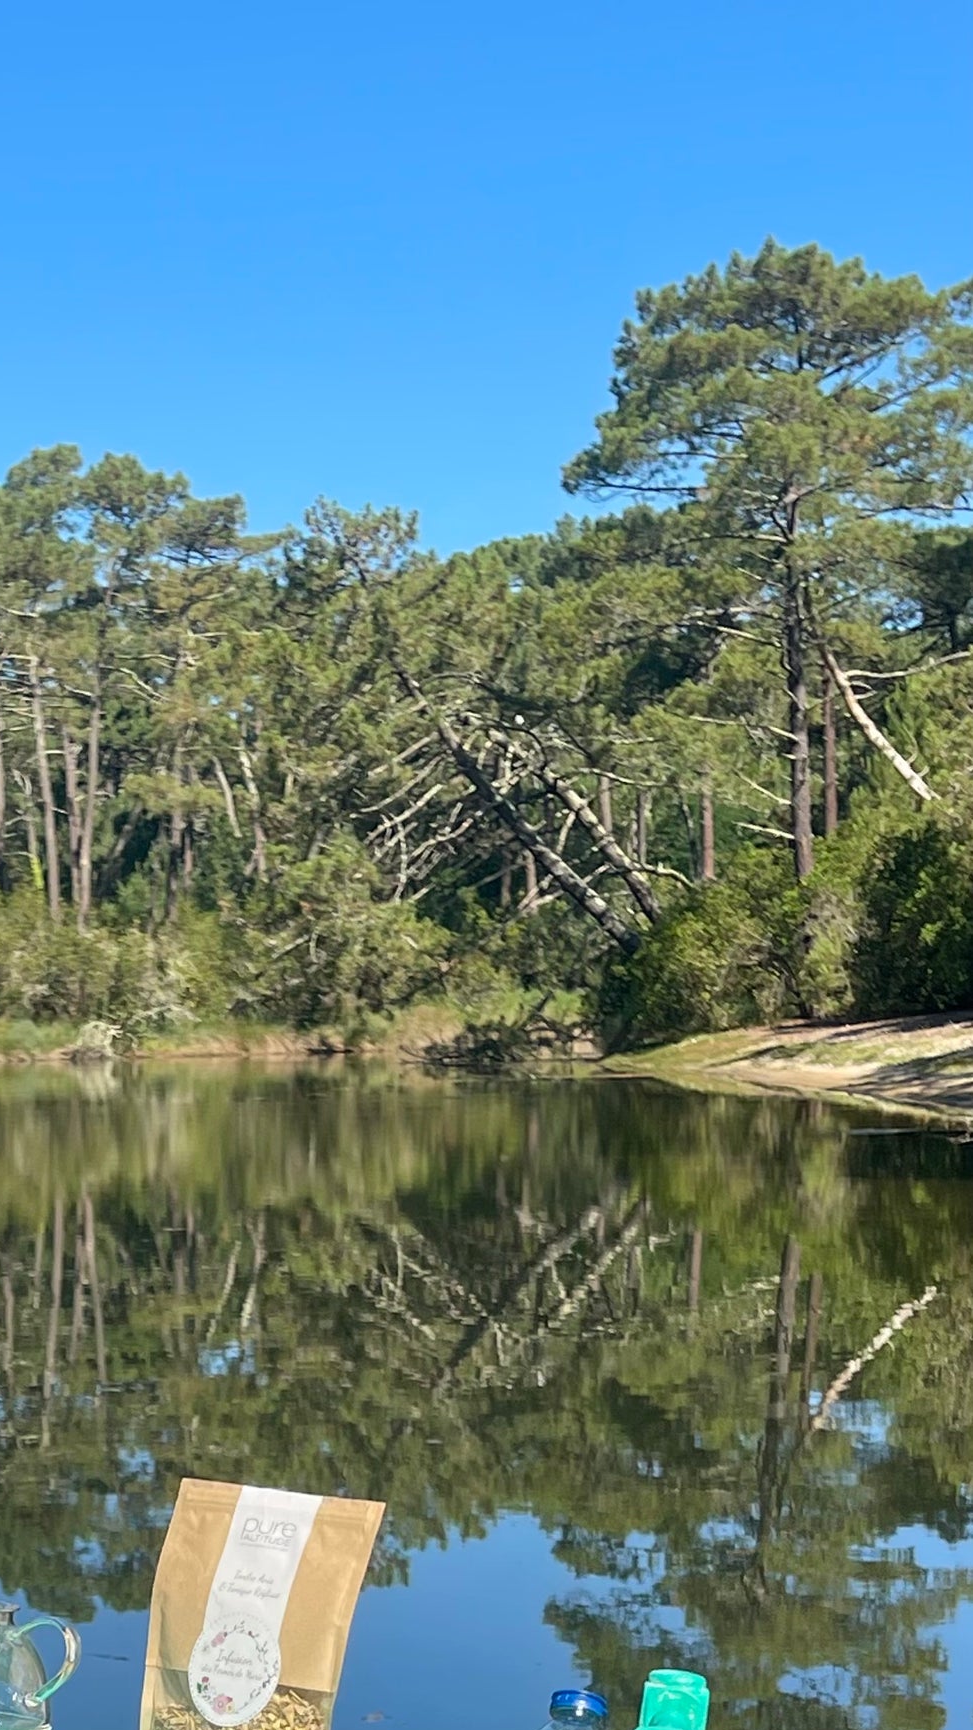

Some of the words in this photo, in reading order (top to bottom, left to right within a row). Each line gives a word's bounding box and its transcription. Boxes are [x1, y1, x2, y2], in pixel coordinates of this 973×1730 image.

[240, 1517, 298, 1540] pure
[243, 1533, 292, 1547] ALTITUDE
[215, 1648, 253, 1665] Infusion
